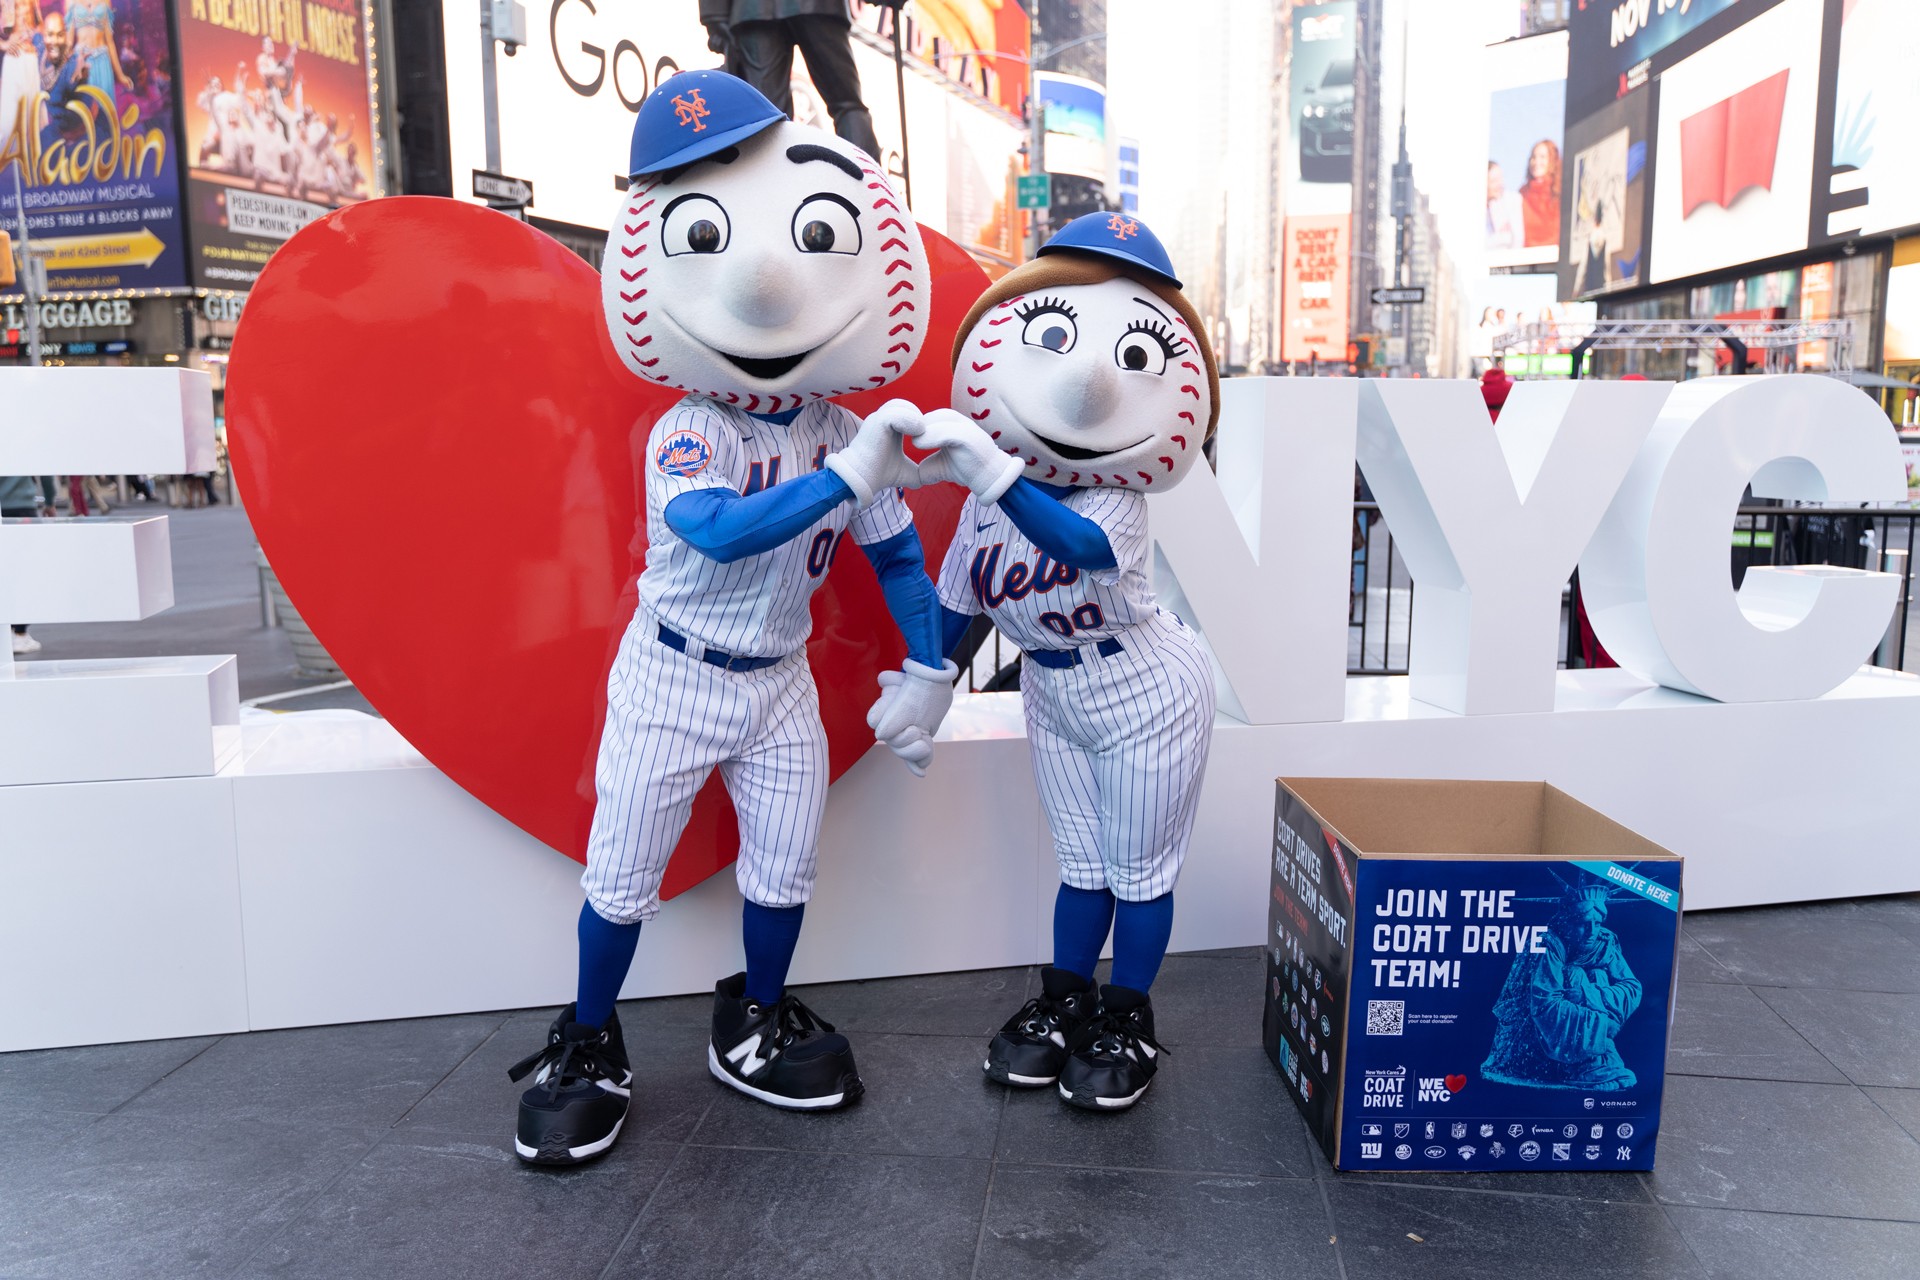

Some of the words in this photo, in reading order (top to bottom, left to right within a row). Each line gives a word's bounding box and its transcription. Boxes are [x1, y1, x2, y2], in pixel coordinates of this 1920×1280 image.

[209, 0, 308, 51] BEAUTIFUL
[306, 2, 359, 65] NOISE
[1610, 0, 1650, 48] NOV
[0, 84, 167, 189] Aladdin
[24, 188, 95, 208] BROADWAY
[98, 183, 156, 203] MUSICAL
[482, 181, 499, 194] ONE
[508, 184, 527, 198] WAY
[27, 215, 56, 228] OMES
[58, 213, 86, 227] TRUE
[97, 209, 140, 224] BLOCKS
[142, 206, 174, 221] AWAY
[232, 197, 286, 214] PEDESTRIAN
[287, 202, 308, 218] FLOW
[234, 213, 256, 227] KEEP
[259, 218, 292, 233] MOVING
[6, 299, 133, 330] LUGGAGE
[663, 446, 701, 467] Mets
[969, 542, 1080, 610] Mets
[1038, 602, 1105, 638] 00
[1276, 815, 1296, 854] COAT
[1295, 834, 1321, 886] DRIVES
[1275, 845, 1290, 882] ARE
[1289, 860, 1296, 890] A
[1297, 869, 1318, 915] TEAM
[1318, 894, 1347, 949] SPORT.
[1606, 865, 1647, 892] DONATE
[1645, 884, 1673, 904] HERE
[1375, 888, 1448, 918] JOIN
[1460, 889, 1516, 918] THE
[1373, 923, 1452, 953] COAT
[1462, 925, 1548, 954] DRIVE
[1371, 958, 1461, 989] TEAM!
[1364, 1077, 1406, 1093] COAT
[1418, 1077, 1445, 1090] WE
[1418, 1089, 1451, 1102] NYC
[1363, 1094, 1404, 1108] DRIVE
[1361, 1142, 1382, 1158] ny
